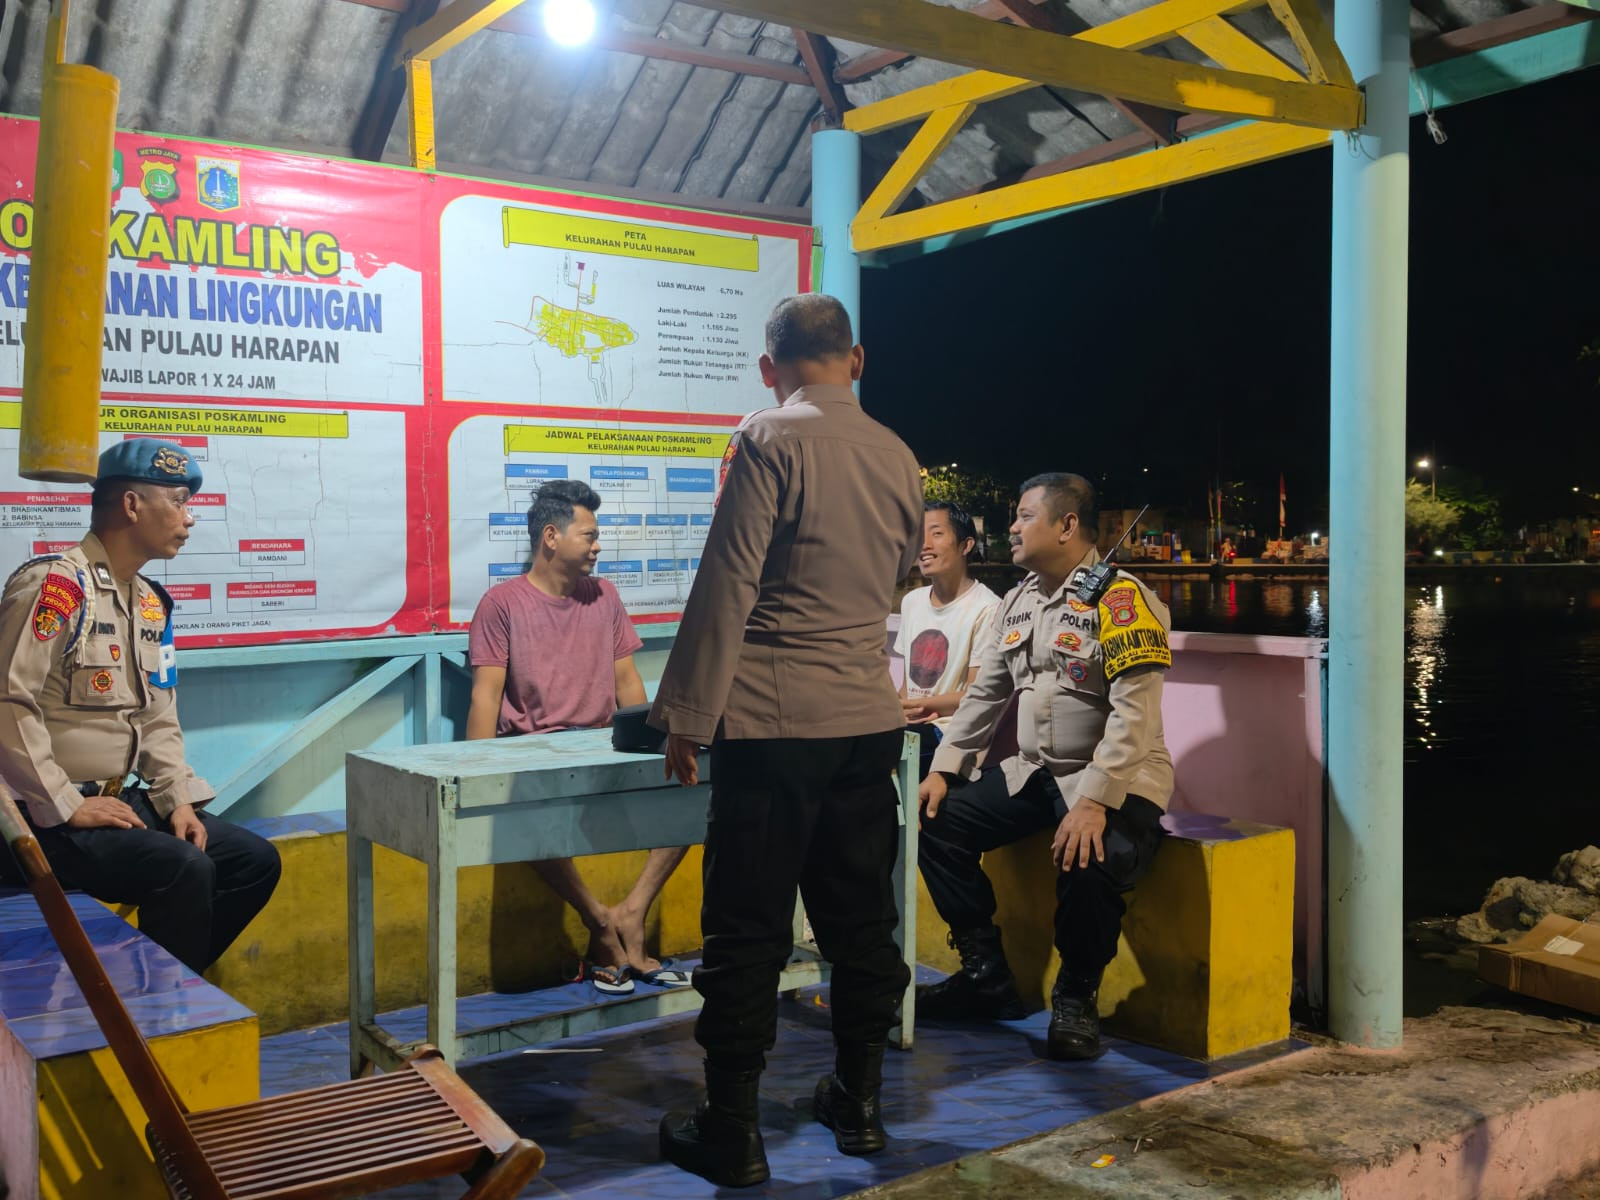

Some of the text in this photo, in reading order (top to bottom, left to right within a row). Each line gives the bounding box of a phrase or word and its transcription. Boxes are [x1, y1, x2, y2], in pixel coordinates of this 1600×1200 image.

[0, 199, 340, 277] OKAMLING
[625, 230, 647, 240] PETA
[565, 233, 695, 257] KELURAHAN PULAU HARAPAN
[657, 281, 675, 289] LUAS
[676, 283, 705, 292] WILAYAH
[189, 278, 382, 332] LINGKUNGAN
[657, 307, 681, 315] Jumlah
[682, 309, 713, 318] Penduduk
[657, 319, 687, 328] Laki-Laki
[657, 332, 694, 342] Perempuan
[141, 330, 223, 357] PULAU
[231, 336, 340, 364] HARAPAN
[657, 345, 681, 353] Jumlah
[657, 358, 681, 366] Jumlah
[657, 370, 681, 378] Jumlah
[148, 370, 196, 386] LAPOR
[201, 373, 207, 387] 1
[213, 373, 223, 388] X
[227, 374, 243, 389] 24
[247, 375, 276, 390] JAM
[120, 408, 200, 422] ORGANISASI
[204, 410, 286, 424] POSKAMLING
[105, 421, 263, 434] KELURAHAN PULAU HARAPAN
[545, 430, 712, 445] JADWAL PELAKSANAAN POSKAMLING
[588, 443, 696, 454] KELURAHAN PULAU HARAPAN
[206, 621, 230, 629] ORANG
[231, 620, 250, 628] PIKET
